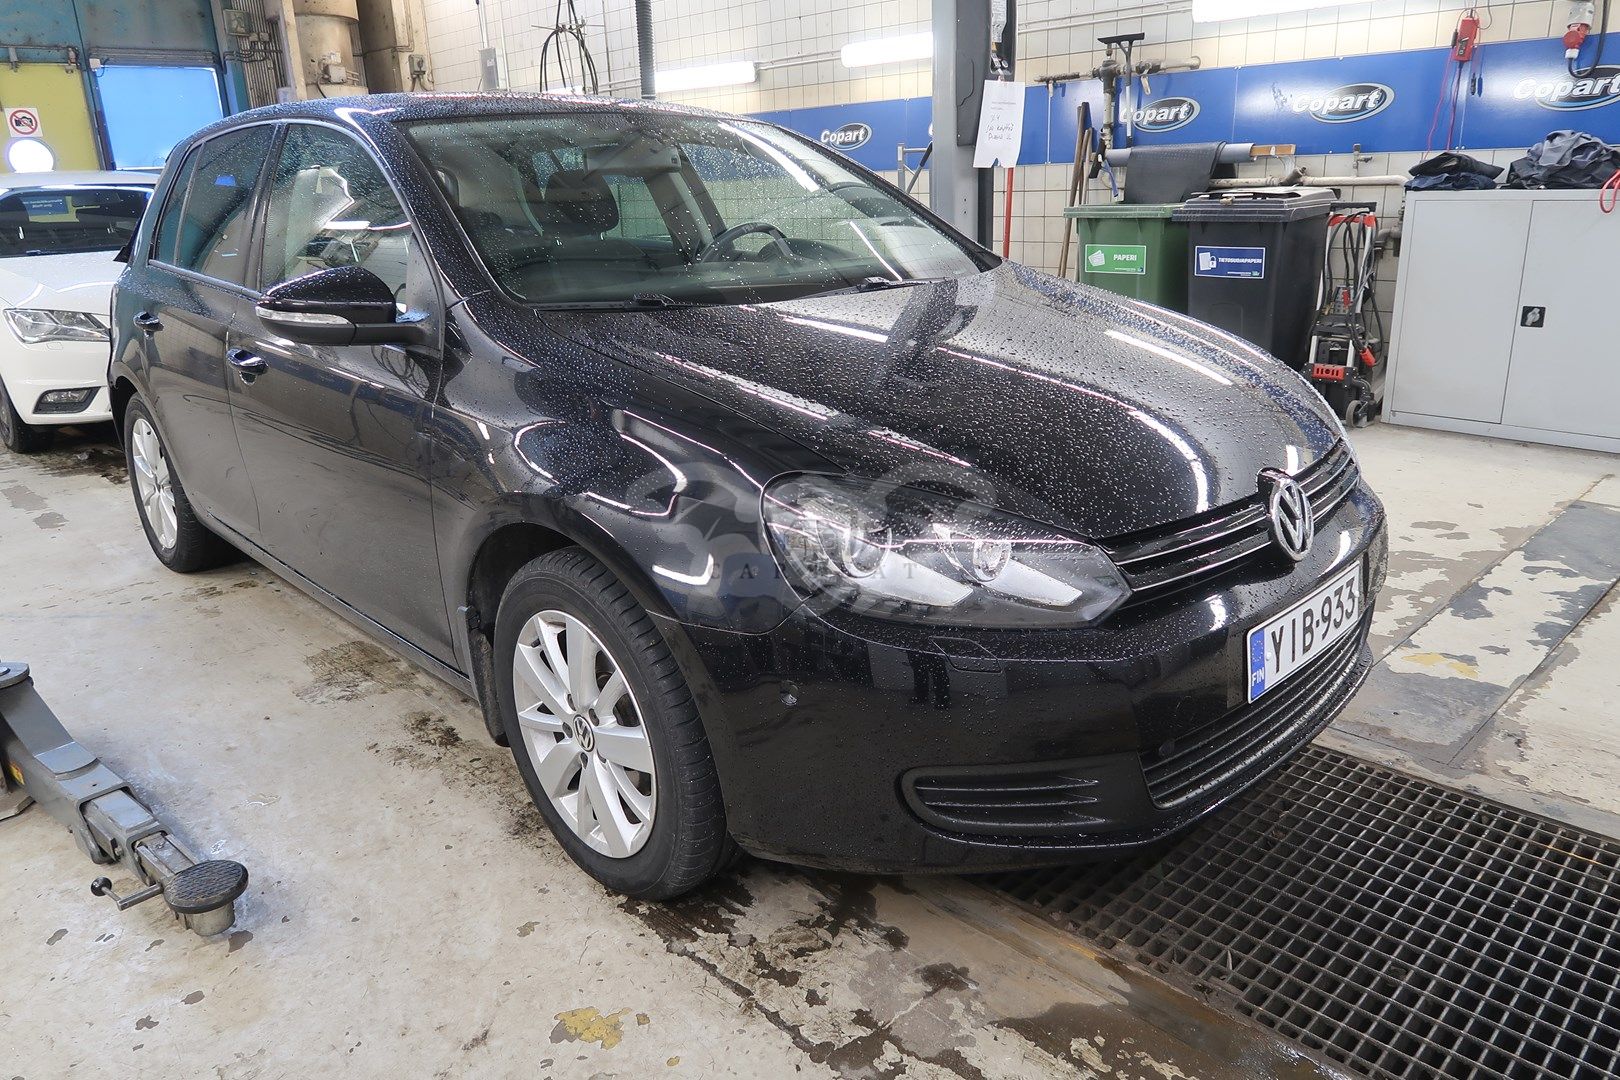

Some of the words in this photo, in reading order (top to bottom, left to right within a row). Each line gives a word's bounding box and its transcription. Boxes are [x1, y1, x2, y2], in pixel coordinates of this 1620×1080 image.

[1292, 88, 1381, 114] Copart
[821, 127, 865, 145] Copart
[1271, 577, 1356, 674] YIB-933
[1252, 667, 1264, 686] FIN
